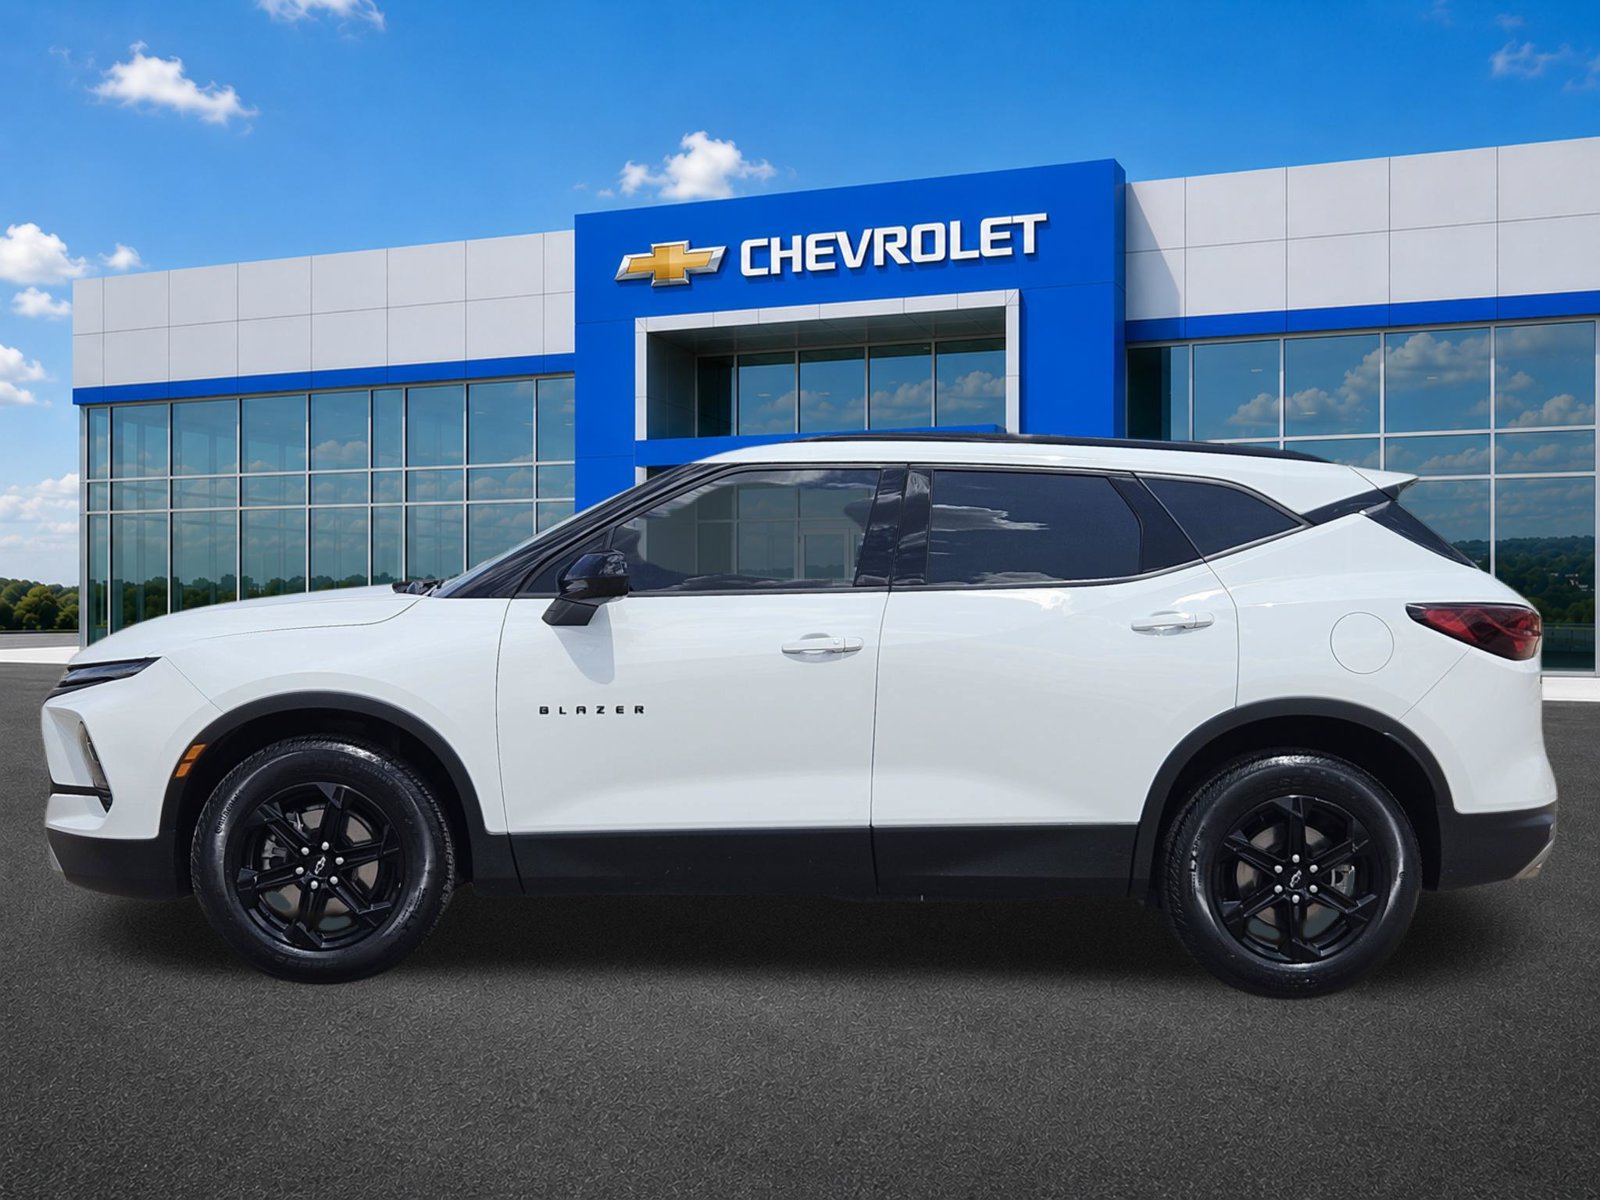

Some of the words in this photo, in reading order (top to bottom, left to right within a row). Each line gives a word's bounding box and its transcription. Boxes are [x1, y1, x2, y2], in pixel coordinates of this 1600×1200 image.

[740, 212, 1047, 277] CHEVROLET
[539, 705, 645, 715] BLAZER
[214, 793, 241, 834] Continental
